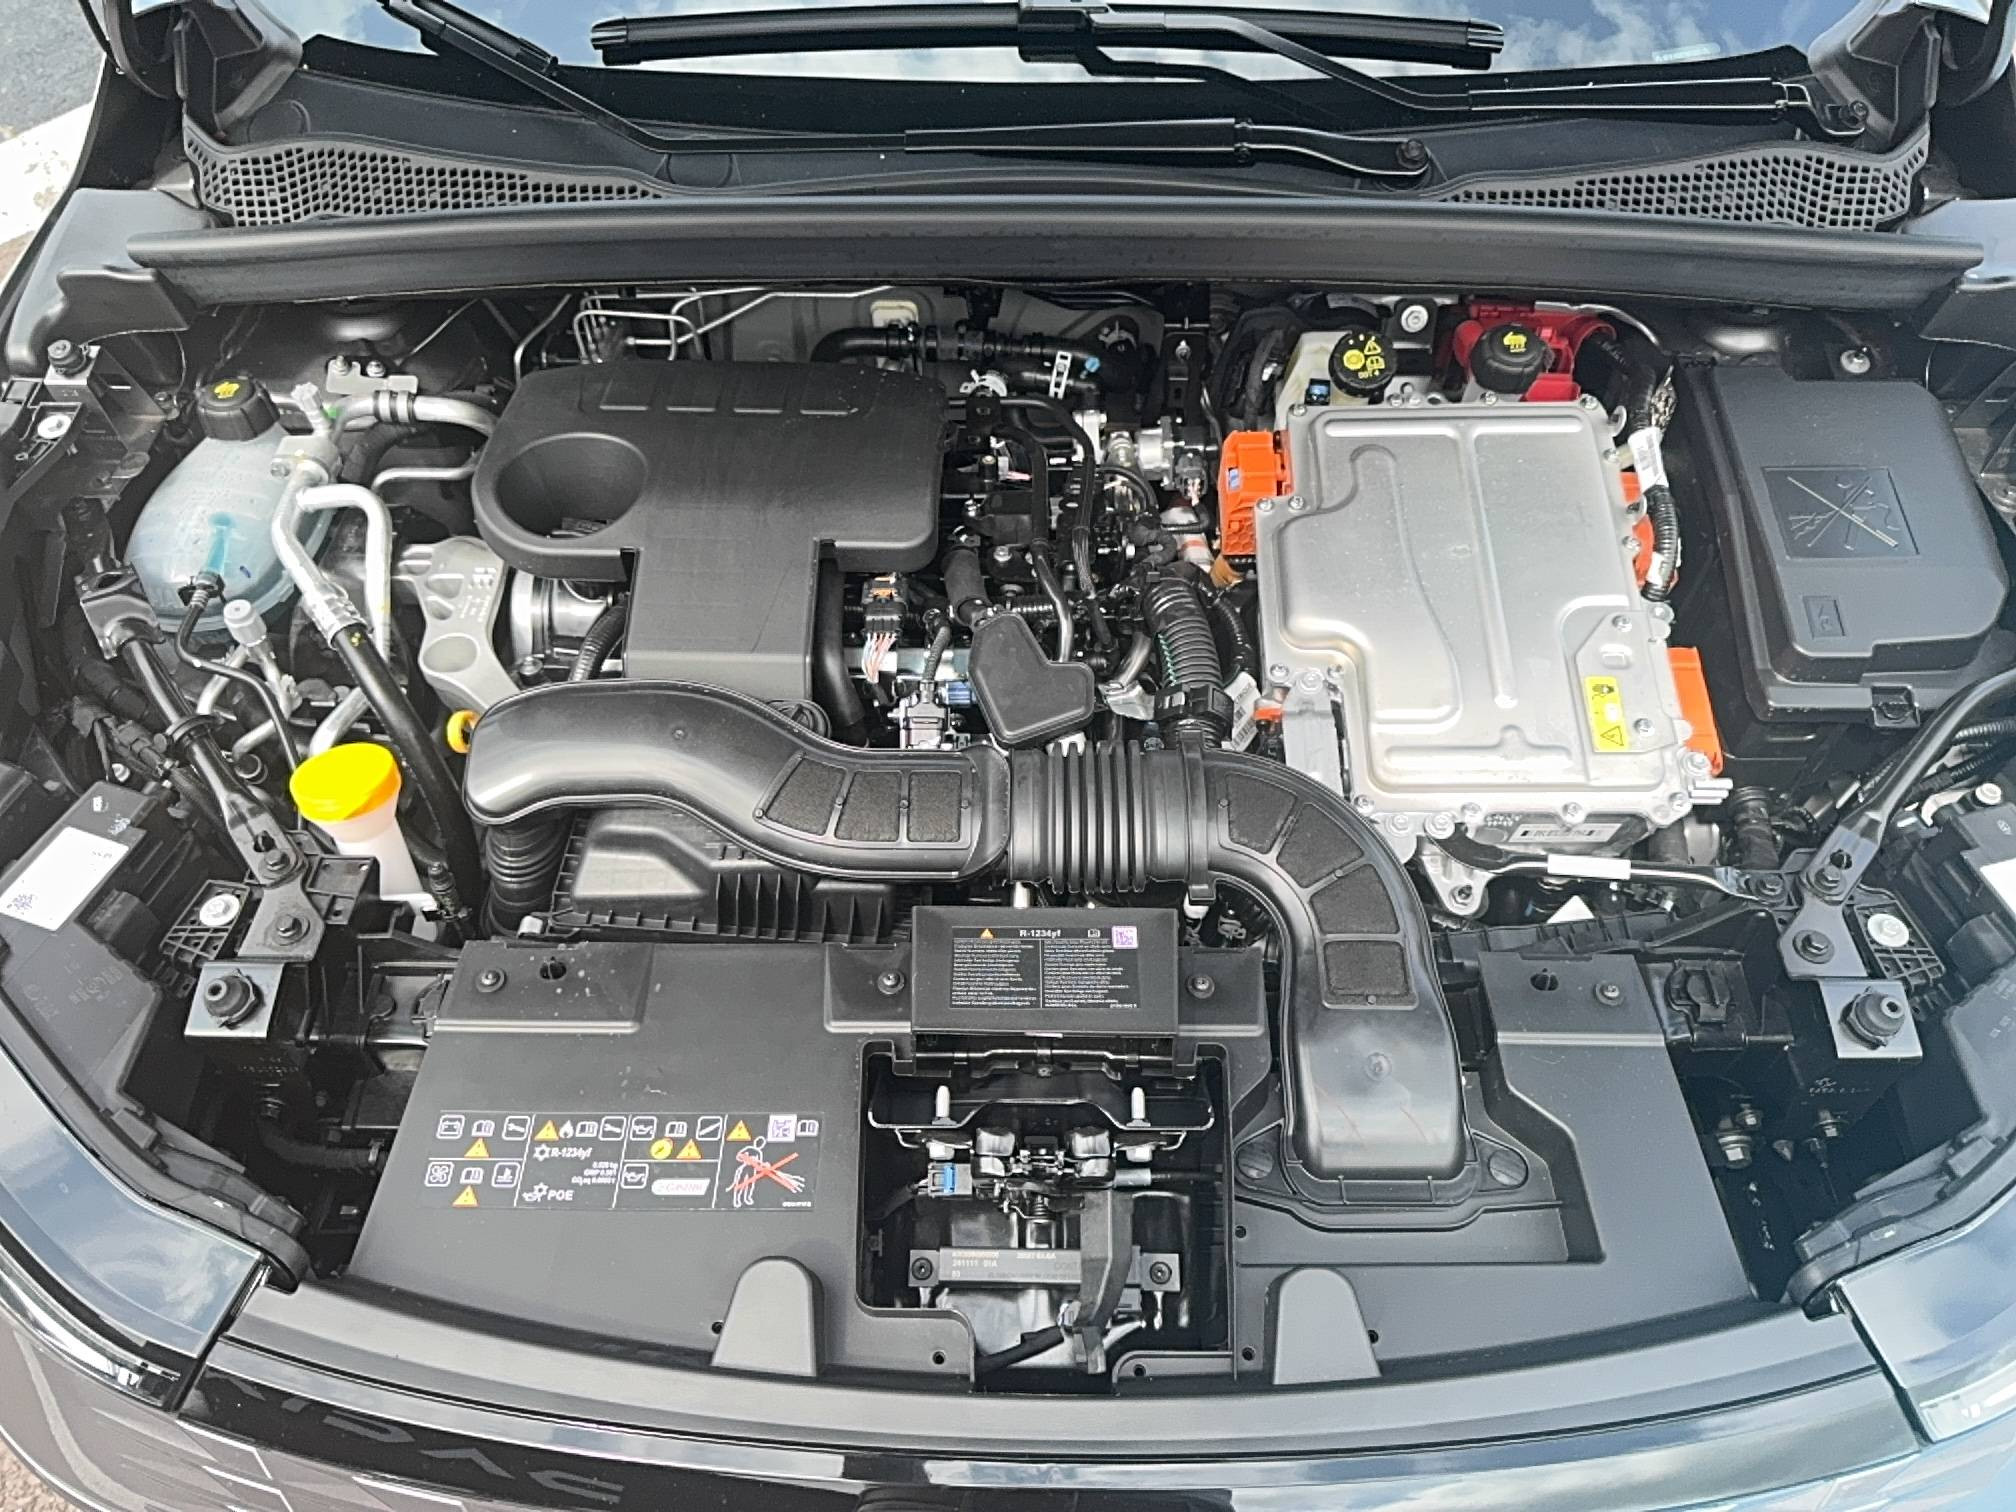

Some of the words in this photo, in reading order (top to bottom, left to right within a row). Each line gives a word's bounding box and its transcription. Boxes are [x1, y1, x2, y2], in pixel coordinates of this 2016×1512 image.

[1019, 929, 1061, 939] R-1234yf
[550, 1147, 593, 1160] R-1234yf
[547, 1189, 574, 1200] POE
